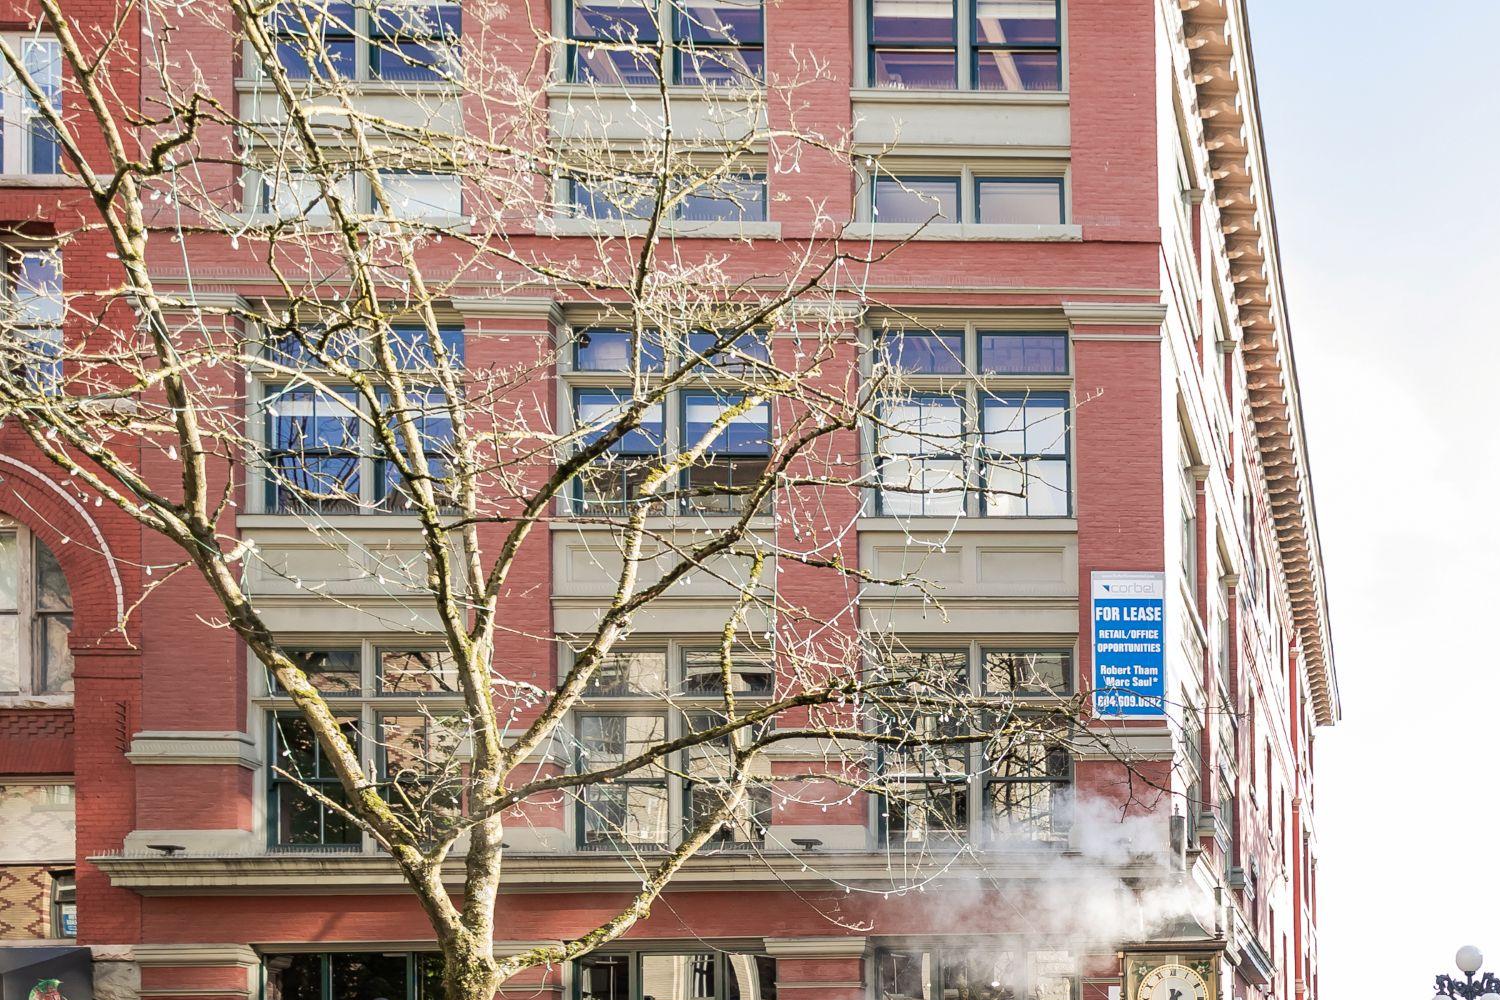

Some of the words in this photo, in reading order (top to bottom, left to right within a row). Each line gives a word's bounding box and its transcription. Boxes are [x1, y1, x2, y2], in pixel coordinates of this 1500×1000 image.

[1110, 582, 1154, 594] corbel
[1095, 606, 1120, 621] FOR
[1123, 606, 1162, 621] LEASE
[1098, 629, 1159, 640] RETAIL/OFFICE
[1097, 643, 1161, 653] OPPORTUNITIES
[1100, 665, 1131, 675] Robert
[1133, 665, 1158, 675] Tham
[1107, 677, 1130, 687] Marc
